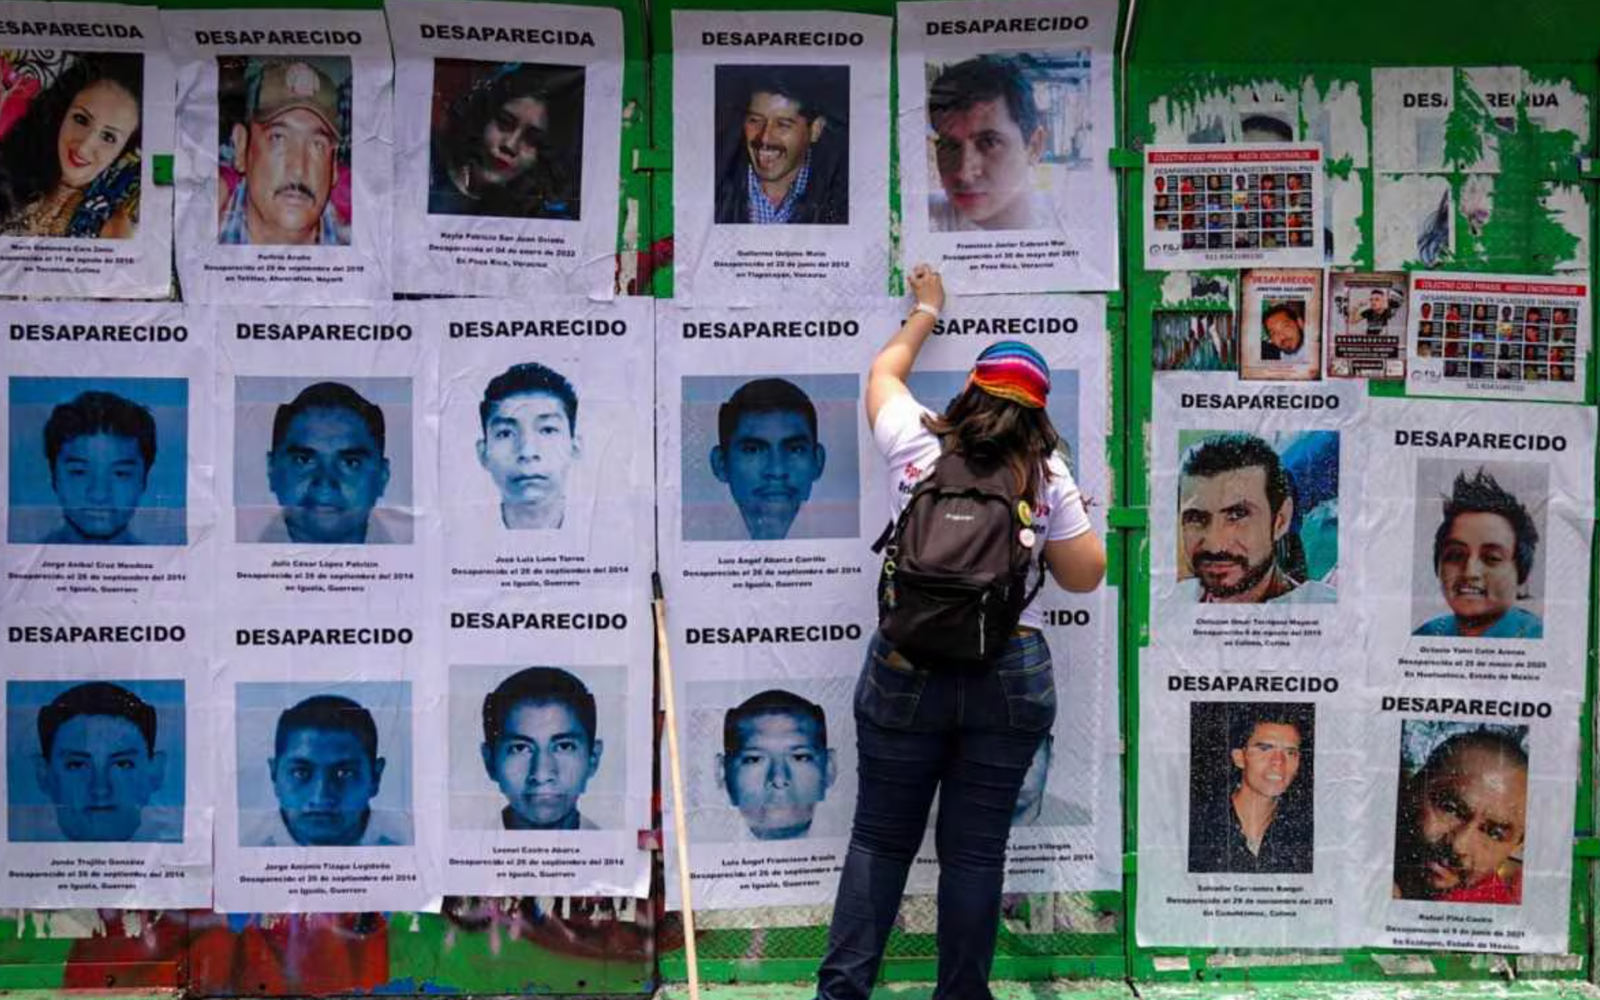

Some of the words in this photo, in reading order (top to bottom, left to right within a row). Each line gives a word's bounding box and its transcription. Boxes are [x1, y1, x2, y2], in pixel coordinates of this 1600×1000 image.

[0, 22, 144, 39] SAPARECIDA
[926, 15, 1089, 36] DESAPARECIDO
[195, 30, 362, 45] DESAPARECIDO
[420, 24, 595, 47] DESAPARECIDA
[701, 31, 864, 47] DESAPARECIDO
[1403, 93, 1559, 108] DESREDA
[9, 324, 188, 343] DESAPARECIDO
[236, 323, 413, 341] DESAPARECIDO
[449, 319, 627, 339] DESAPARECIDO
[682, 320, 859, 339] DESAPARECIDO
[901, 317, 1079, 335] SAPARECIDO
[1181, 393, 1340, 410] DESAPARECIDO
[1394, 430, 1567, 452] DESAPARECIDO
[450, 612, 628, 630] DESAPARECIDO
[8, 625, 186, 643] DESAPARECIDO
[236, 628, 413, 646] DESAPARECIDO
[686, 623, 862, 645] DESAPARECIDO
[1168, 675, 1339, 693] DESAPARECIDO
[1381, 696, 1552, 719] DESAPARECIDO
